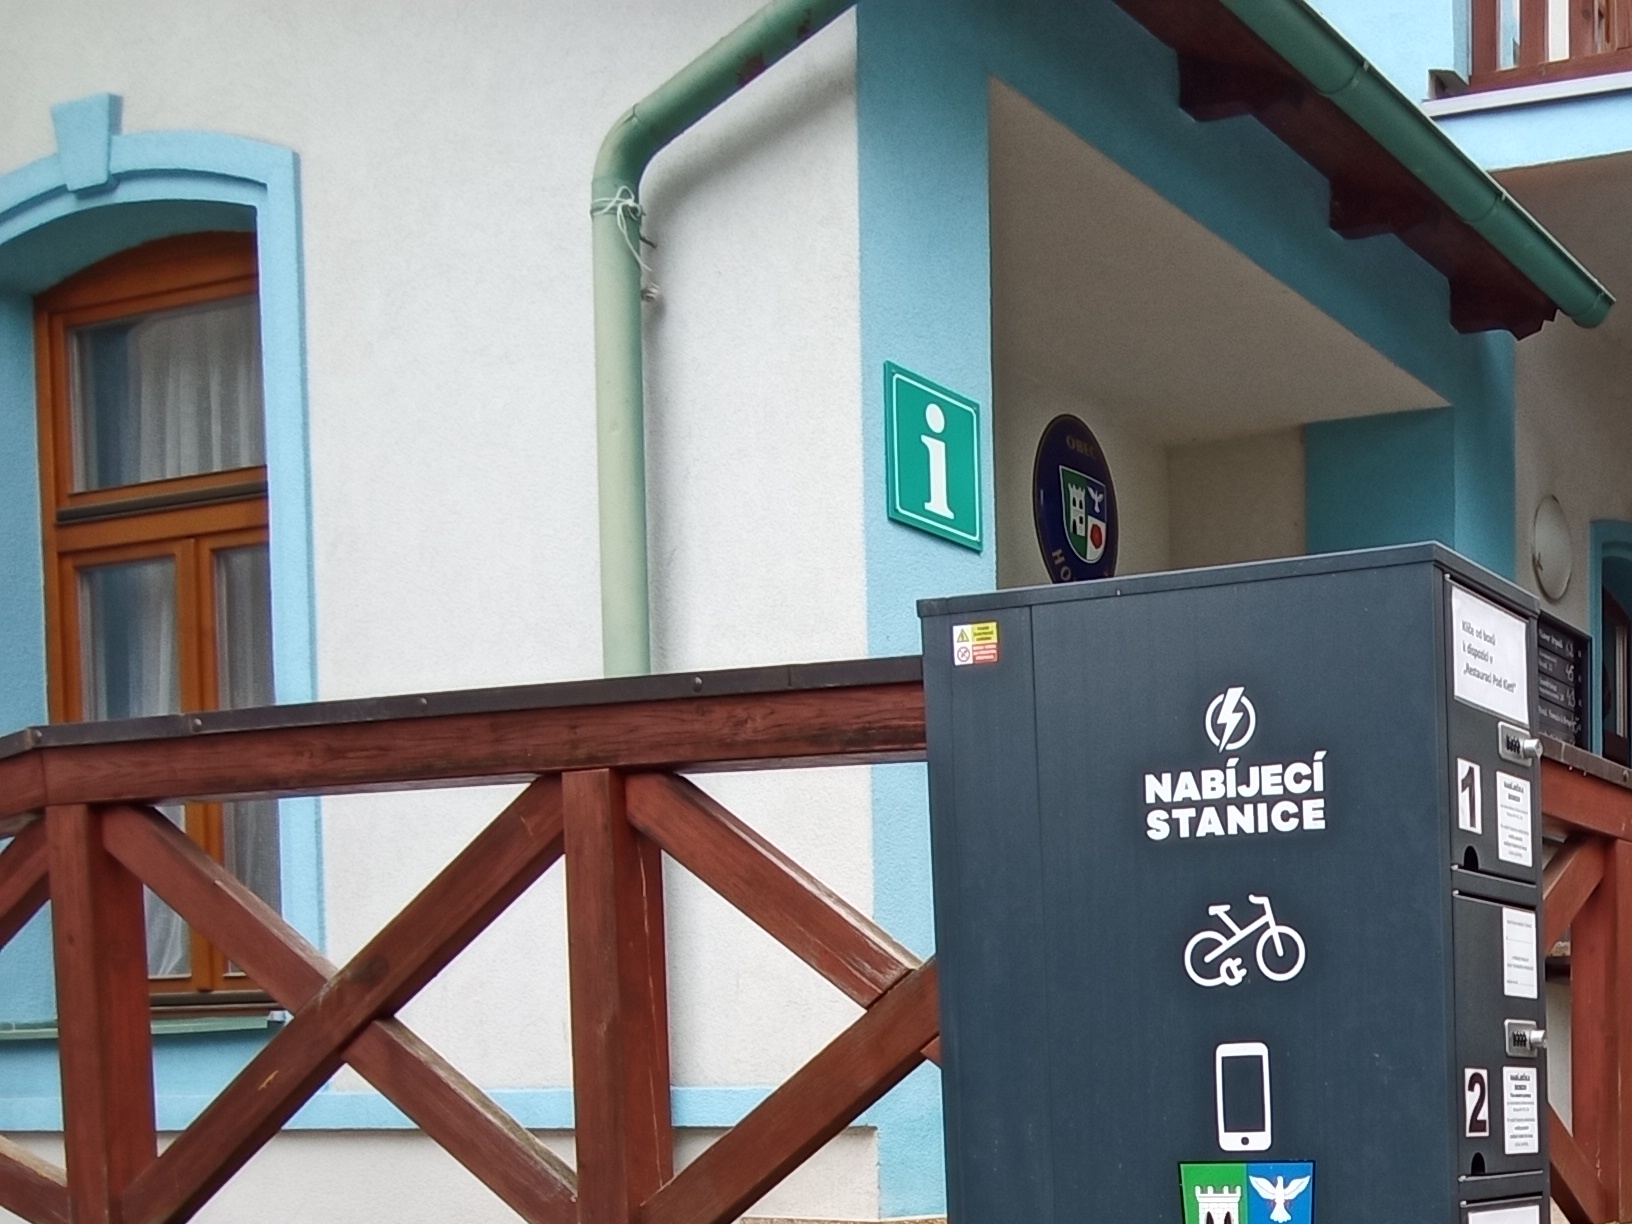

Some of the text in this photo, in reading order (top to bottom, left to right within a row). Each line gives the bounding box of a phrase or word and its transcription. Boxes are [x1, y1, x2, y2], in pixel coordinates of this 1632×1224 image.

[921, 403, 954, 519] i
[1145, 750, 1327, 804] NABÍJECÍ
[1461, 766, 1476, 828] 1
[1146, 798, 1326, 840] STANICE
[1468, 1072, 1487, 1133] 2
